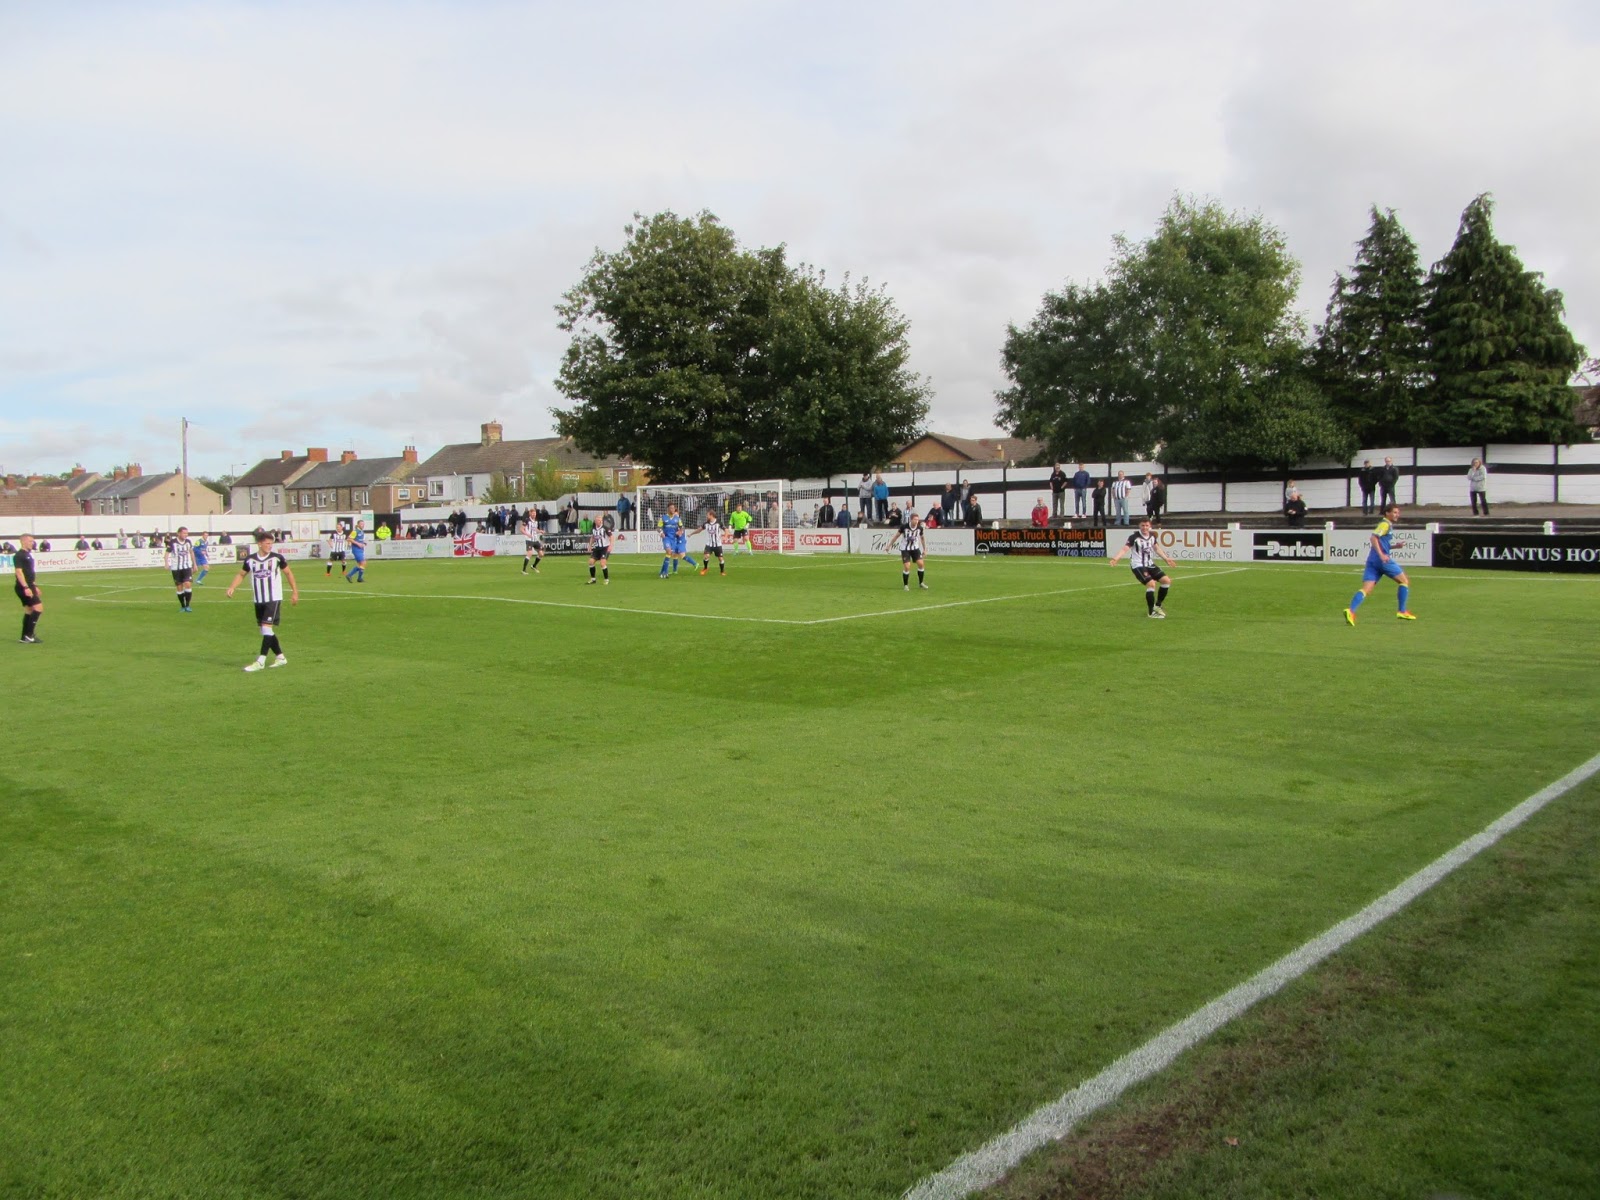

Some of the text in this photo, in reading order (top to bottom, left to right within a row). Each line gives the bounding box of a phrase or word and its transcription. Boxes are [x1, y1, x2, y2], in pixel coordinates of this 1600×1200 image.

[806, 536, 840, 544] EVO-STIK
[976, 530, 1104, 540] North East Truck & Trailer Ltd
[1150, 531, 1232, 548] O-LINE
[1218, 551, 1232, 559] Ltd
[1267, 541, 1324, 557] Parker
[1330, 546, 1358, 558] Racor
[1470, 546, 1561, 561] AILANTUS
